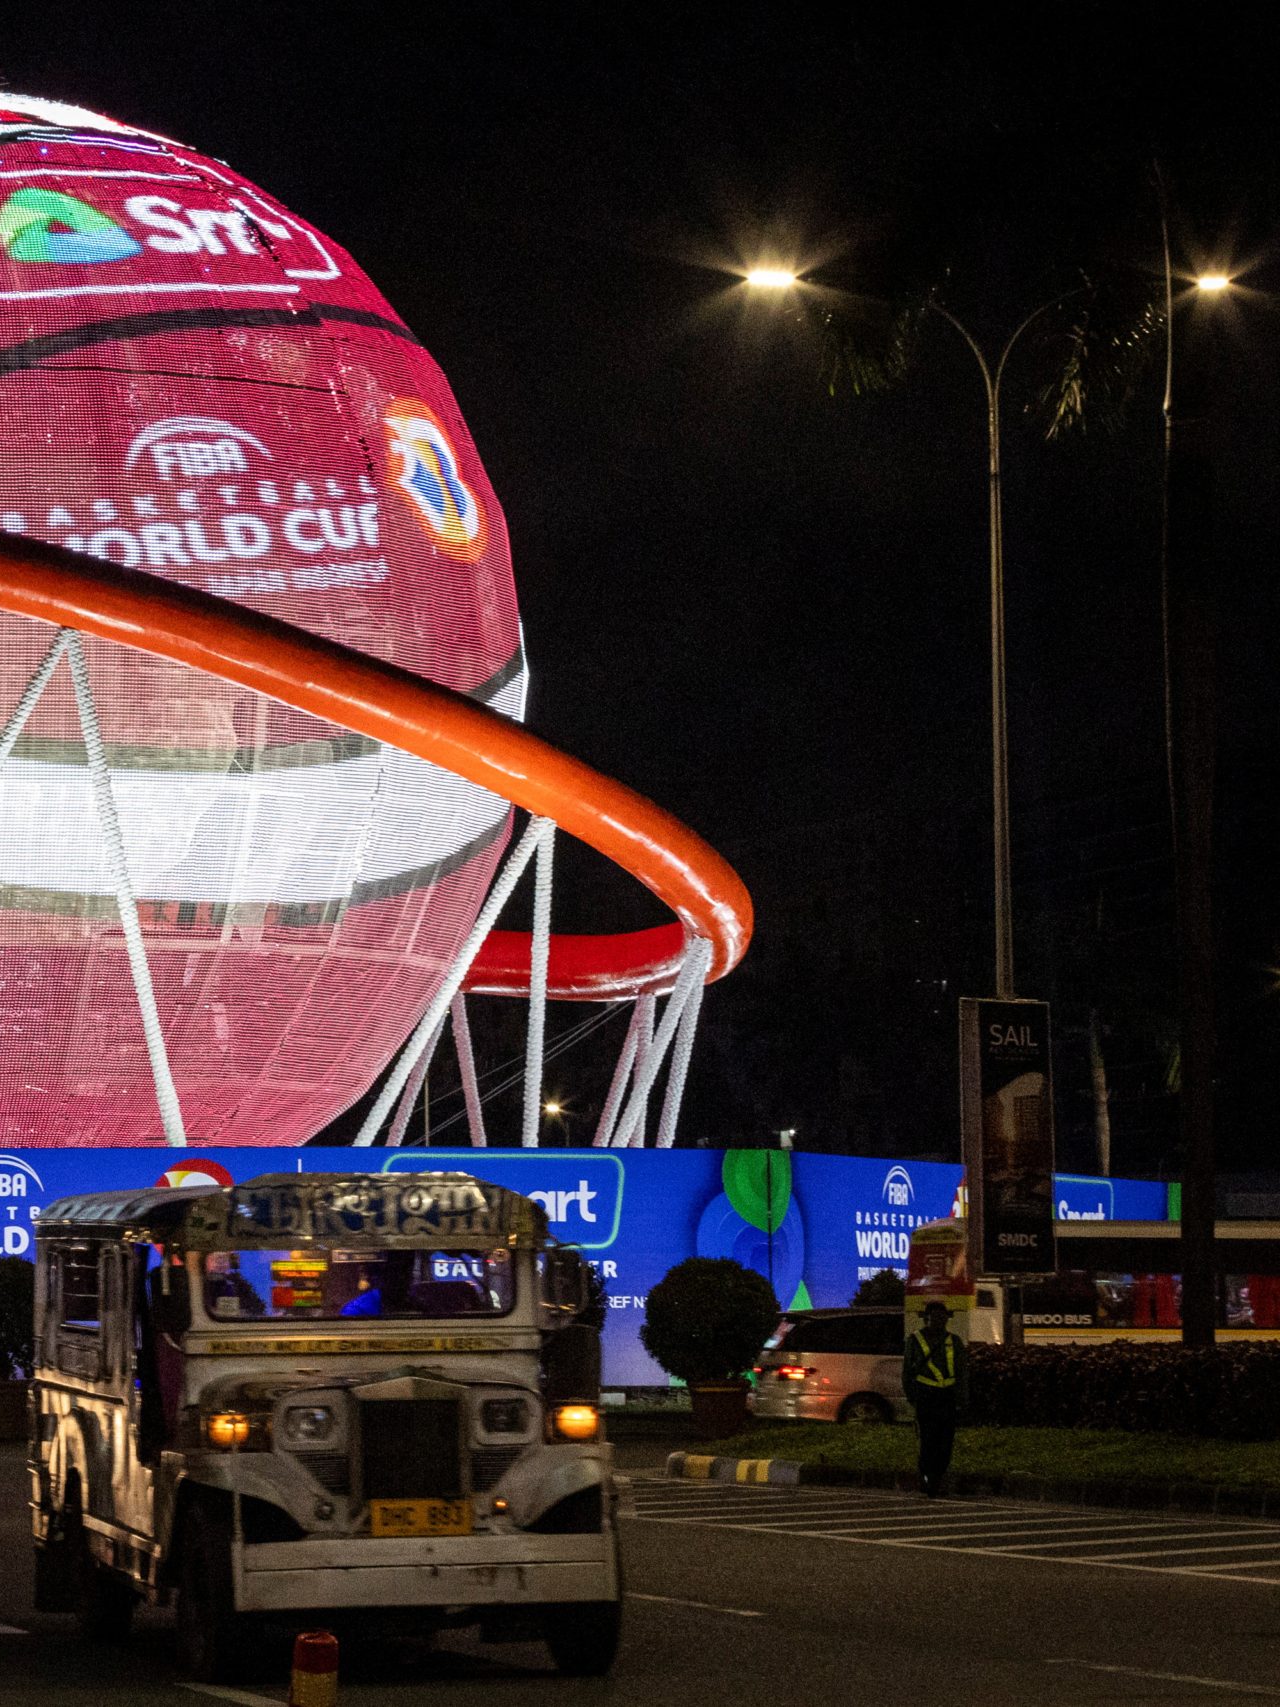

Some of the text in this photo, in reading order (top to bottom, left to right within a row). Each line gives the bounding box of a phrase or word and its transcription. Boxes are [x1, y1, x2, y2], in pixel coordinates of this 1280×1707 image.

[152, 438, 247, 480] FIBA
[989, 1023, 1038, 1047] SAIL
[528, 1180, 597, 1223] art
[888, 1182, 909, 1206] FIBA
[855, 1230, 910, 1260] WORLD
[998, 1233, 1038, 1247] SMDC
[1022, 1314, 1063, 1325] EWOO
[1065, 1314, 1092, 1325] BUS
